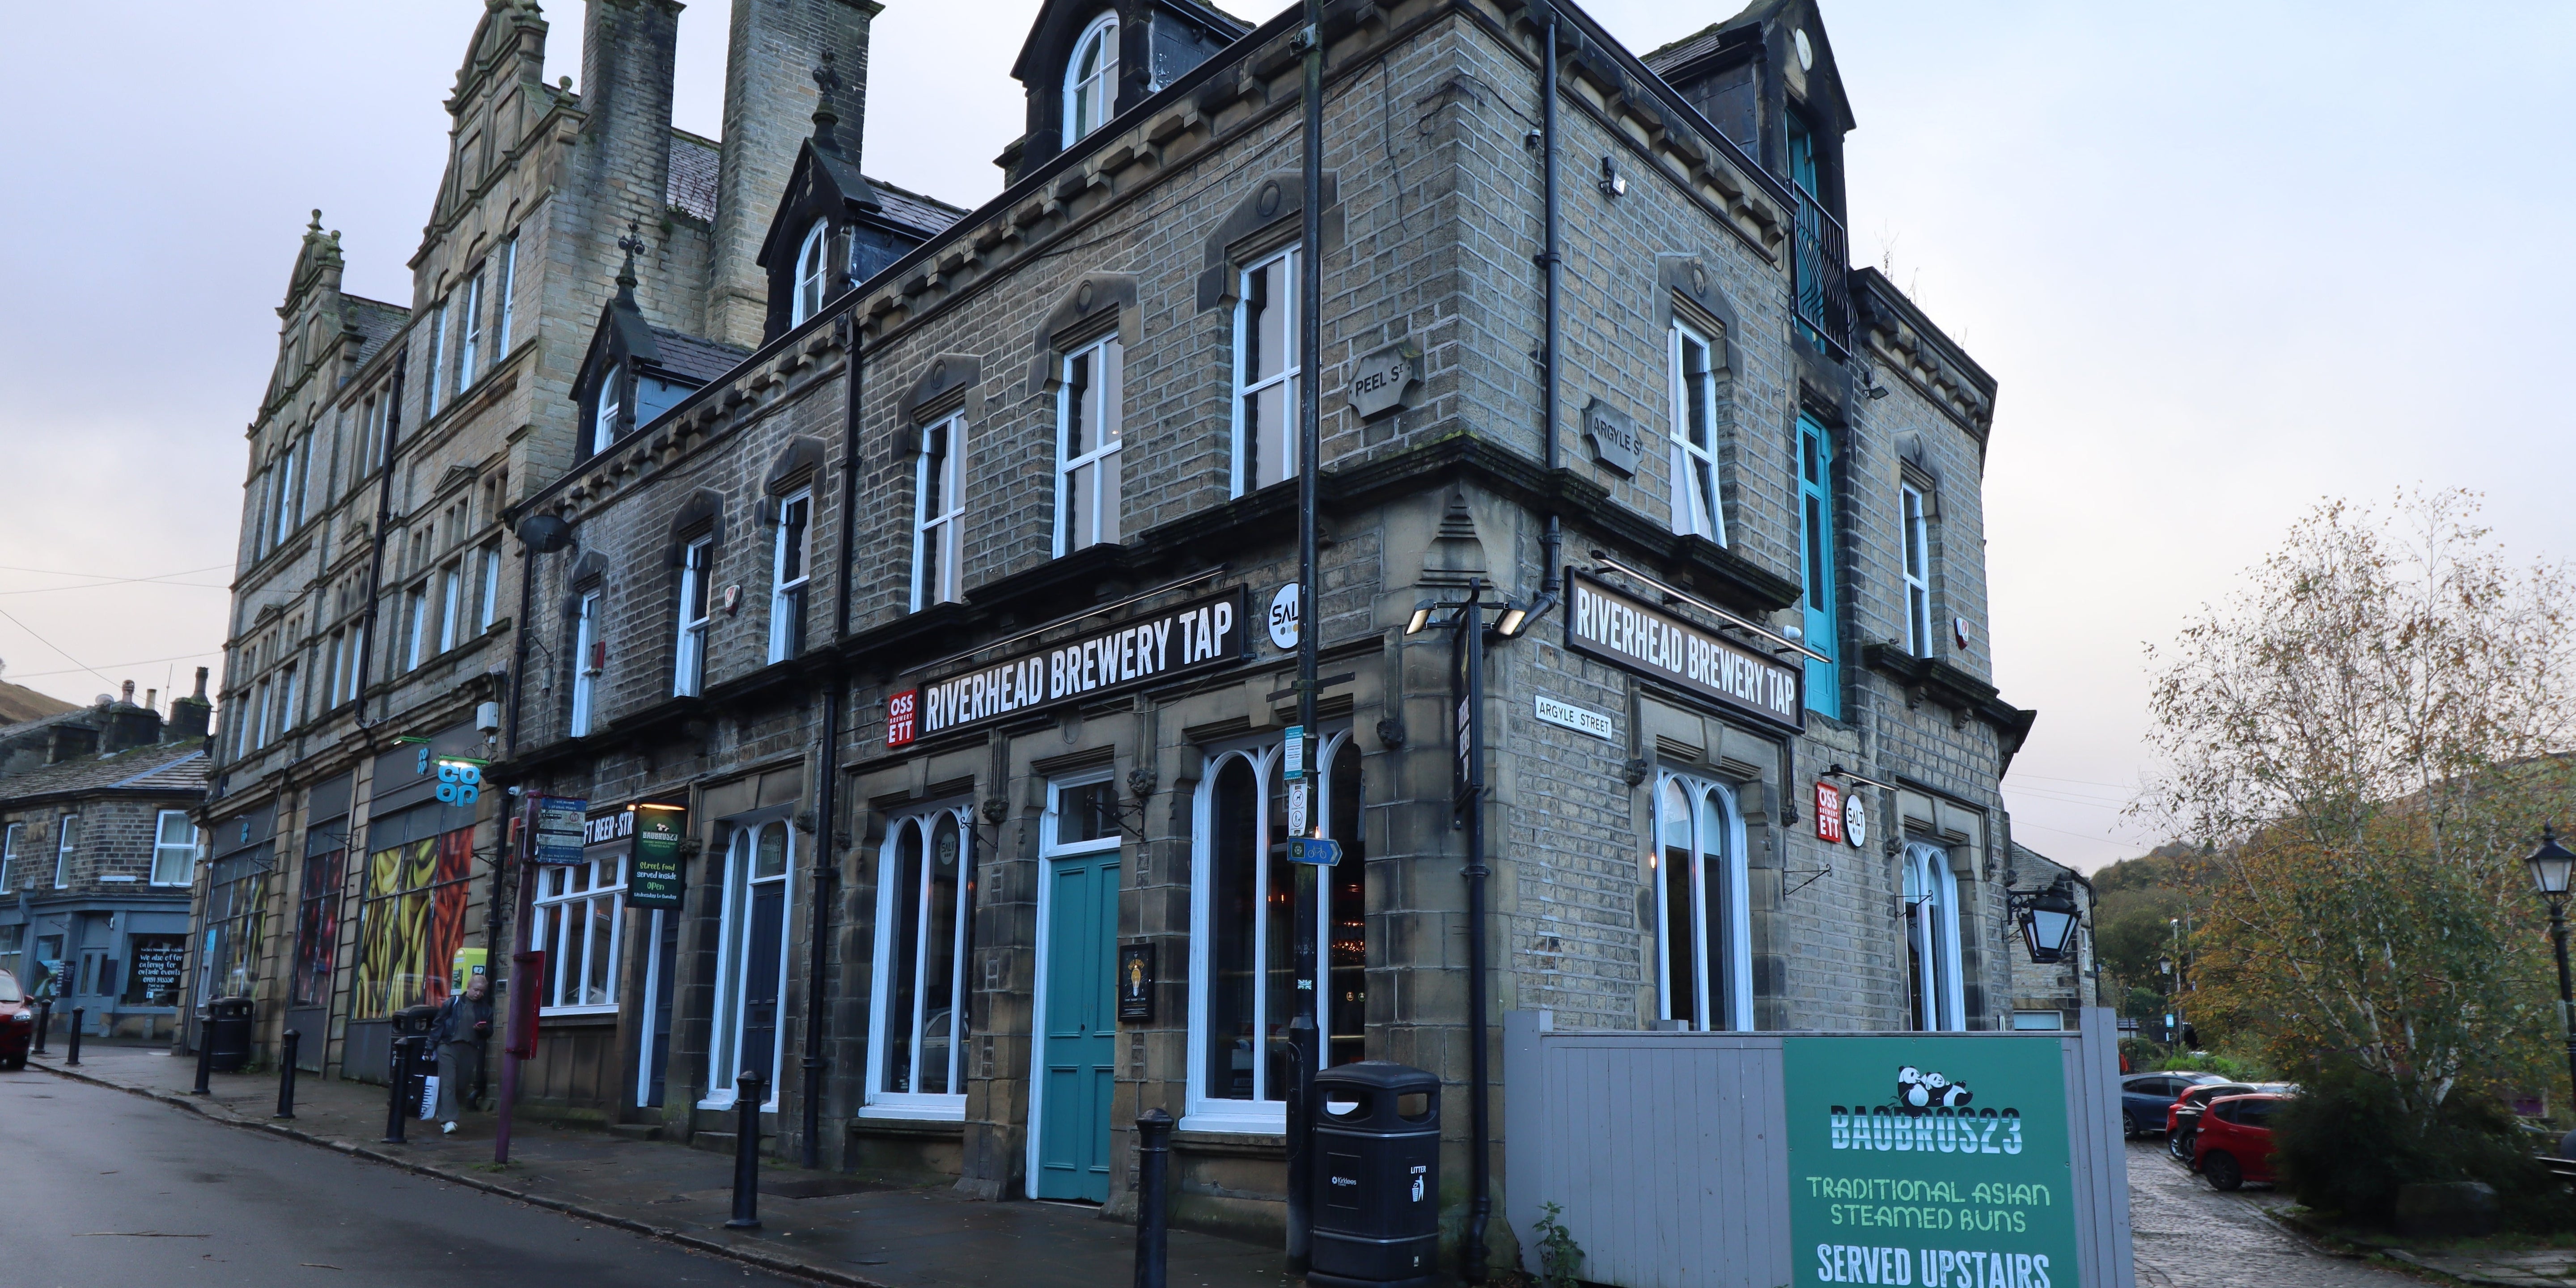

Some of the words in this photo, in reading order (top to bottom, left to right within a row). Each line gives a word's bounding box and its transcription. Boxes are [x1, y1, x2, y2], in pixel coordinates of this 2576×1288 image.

[1356, 372, 1386, 397] PEEL
[1594, 417, 1630, 452] ARGYLE
[1272, 601, 1298, 626] SAL
[1577, 587, 1682, 673] RIVERHEAD
[1688, 634, 1763, 705] BREWERY
[1767, 668, 1794, 716] TAP
[926, 657, 1043, 732] RIVERHEAD
[1051, 618, 1171, 699] BREWERY
[1179, 602, 1232, 665] TAP
[891, 695, 913, 716] OSS
[1540, 702, 1574, 723] ARGYLE
[1580, 713, 1609, 733] STREET
[890, 713, 912, 724] BREWERY
[889, 720, 912, 743] ETT
[1819, 788, 1838, 810] OSS
[1820, 807, 1838, 818] BREWERY
[1848, 808, 1863, 828] SALT
[594, 815, 614, 842] BEER
[1820, 814, 1839, 839] ETT
[941, 841, 955, 853] SALT
[640, 861, 660, 870] Street
[658, 872, 676, 880] inside
[139, 961, 164, 970] catering
[1831, 1106, 2022, 1154] BAOBROS23
[1338, 1177, 1356, 1185] Kirklees
[1411, 1165, 1426, 1174] LITTER
[1806, 1177, 1966, 1203] TRADITIONAL
[1971, 1182, 2051, 1206] ASIAN
[1831, 1204, 1953, 1230] STEAMED
[1961, 1208, 2026, 1233] BUNS
[1817, 1244, 1911, 1286] SERVED
[1921, 1249, 2051, 1288] UPSTAIRS
